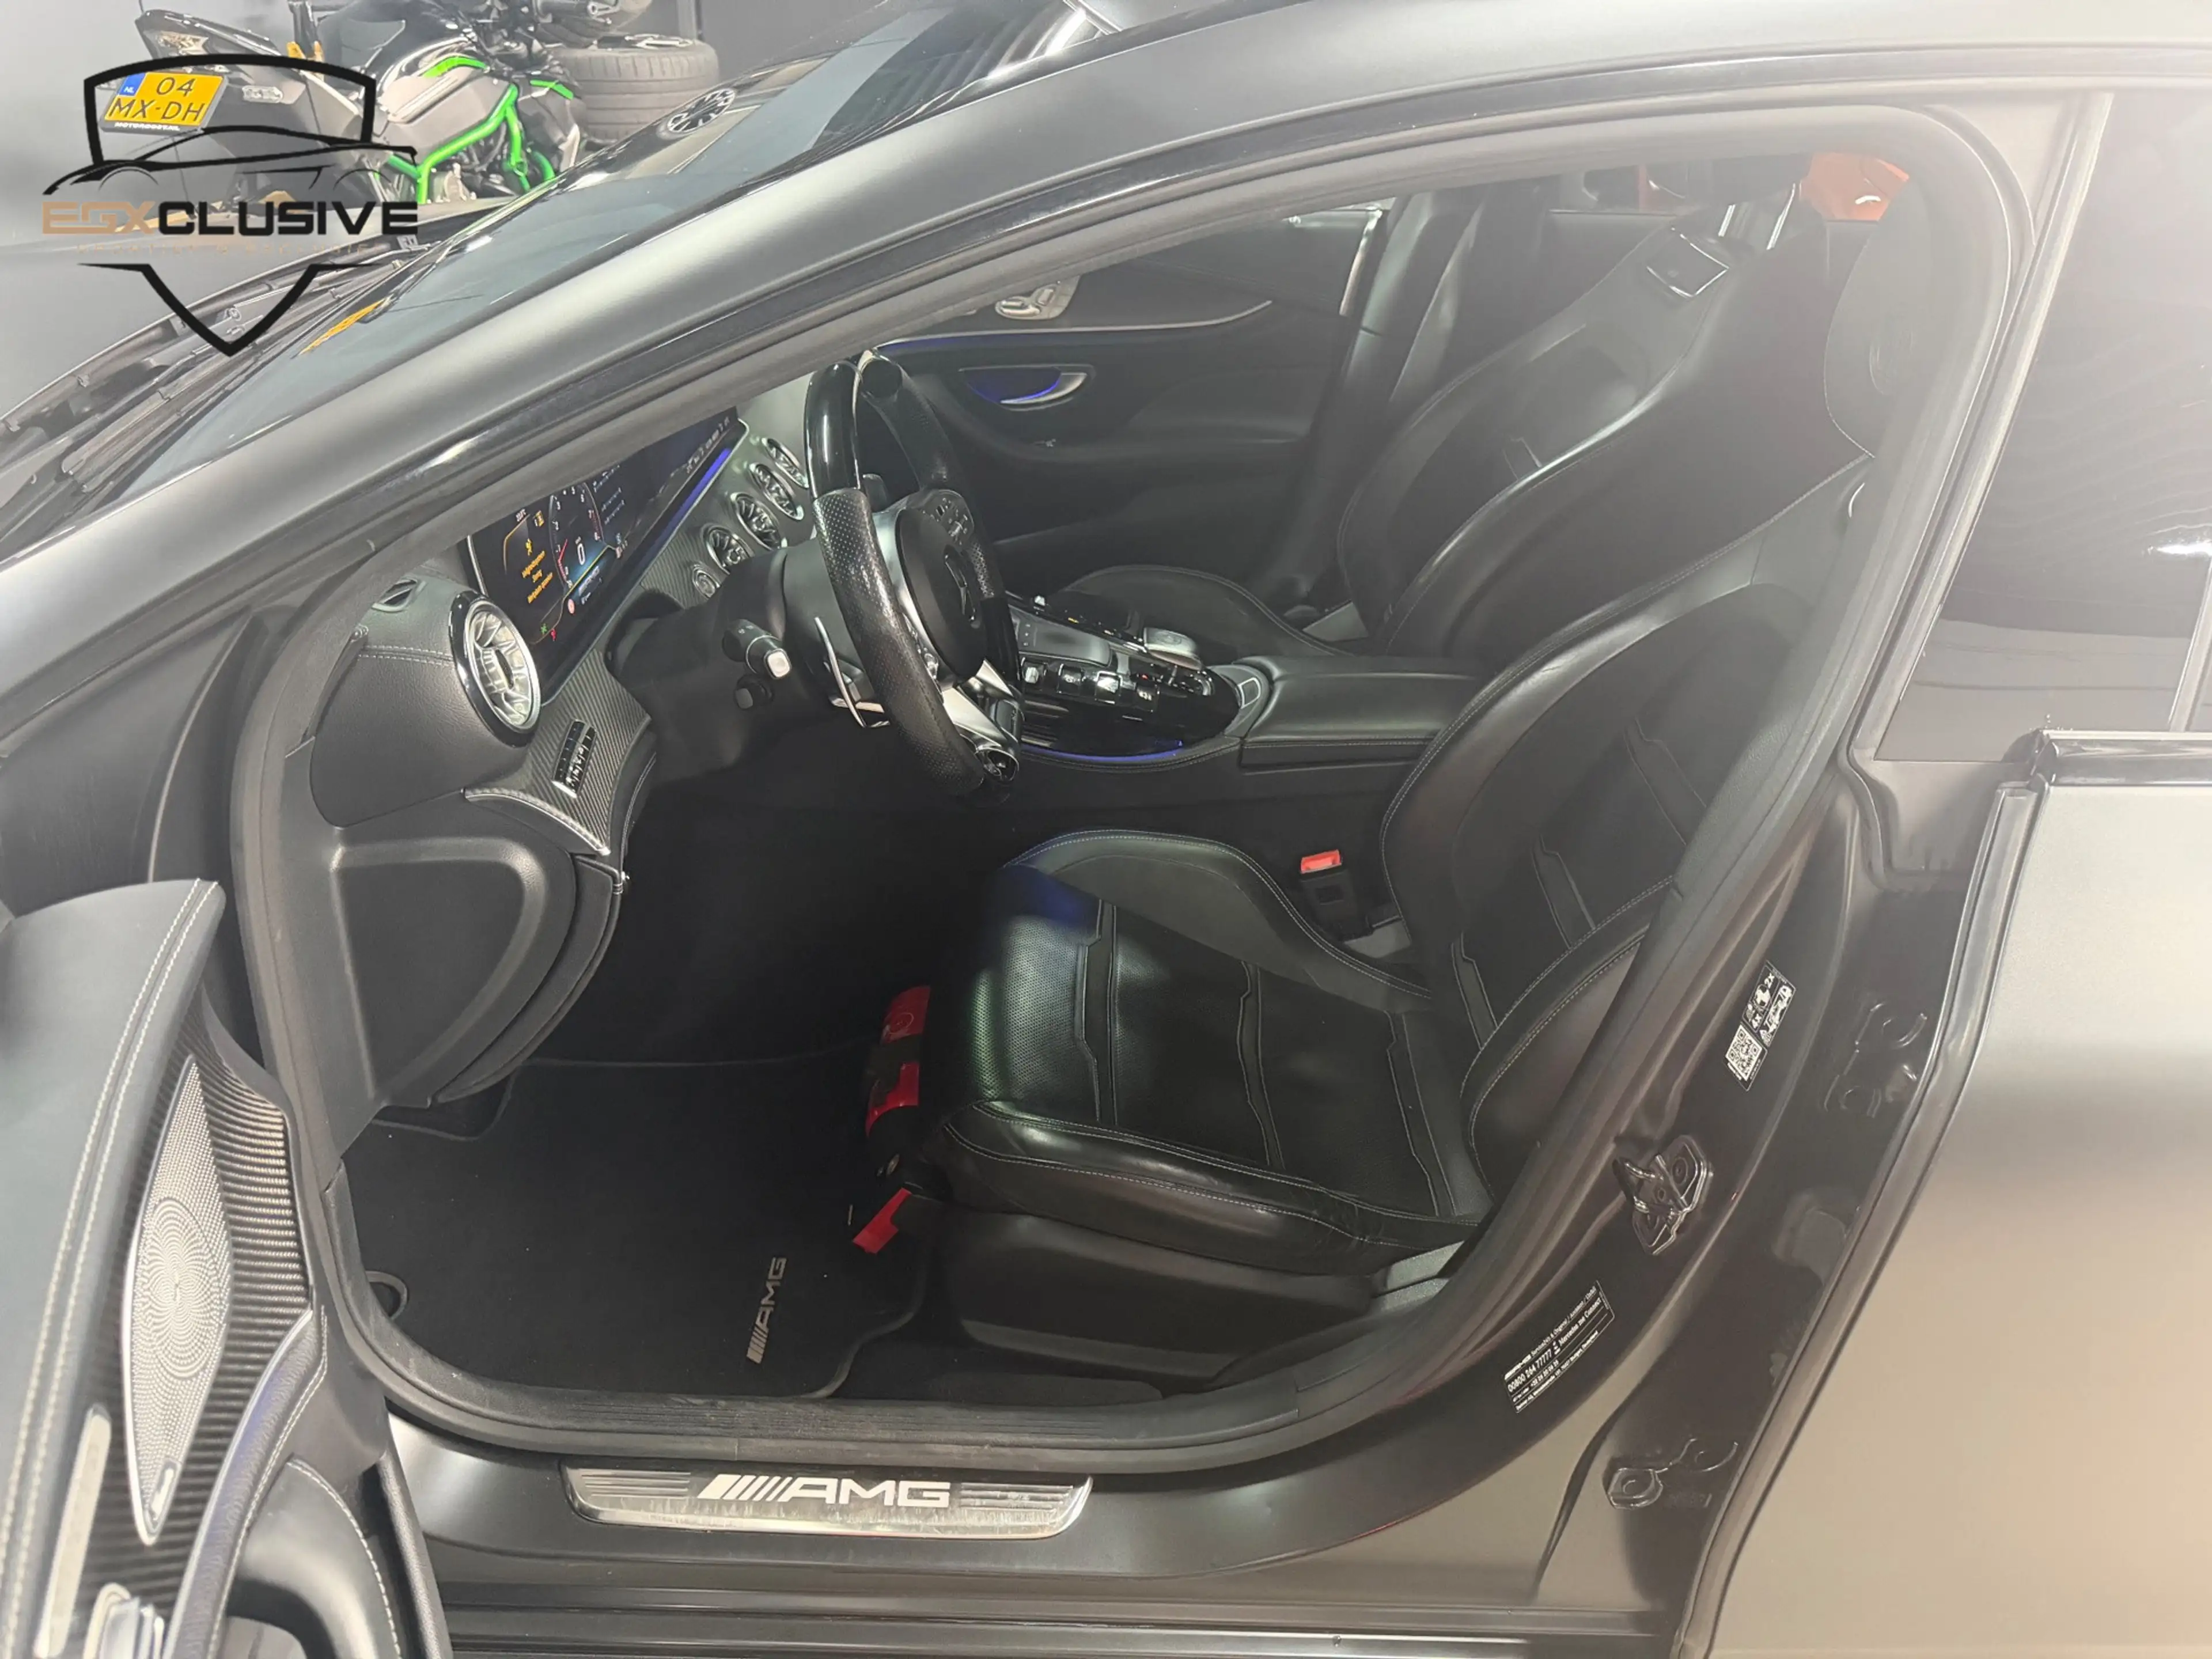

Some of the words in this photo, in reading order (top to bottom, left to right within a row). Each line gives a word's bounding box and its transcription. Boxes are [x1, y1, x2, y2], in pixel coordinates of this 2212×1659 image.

[156, 77, 196, 97] 04
[108, 97, 206, 122] MX-DH
[1508, 1373, 1527, 1393] 00800
[1535, 1348, 1552, 1369] 77777
